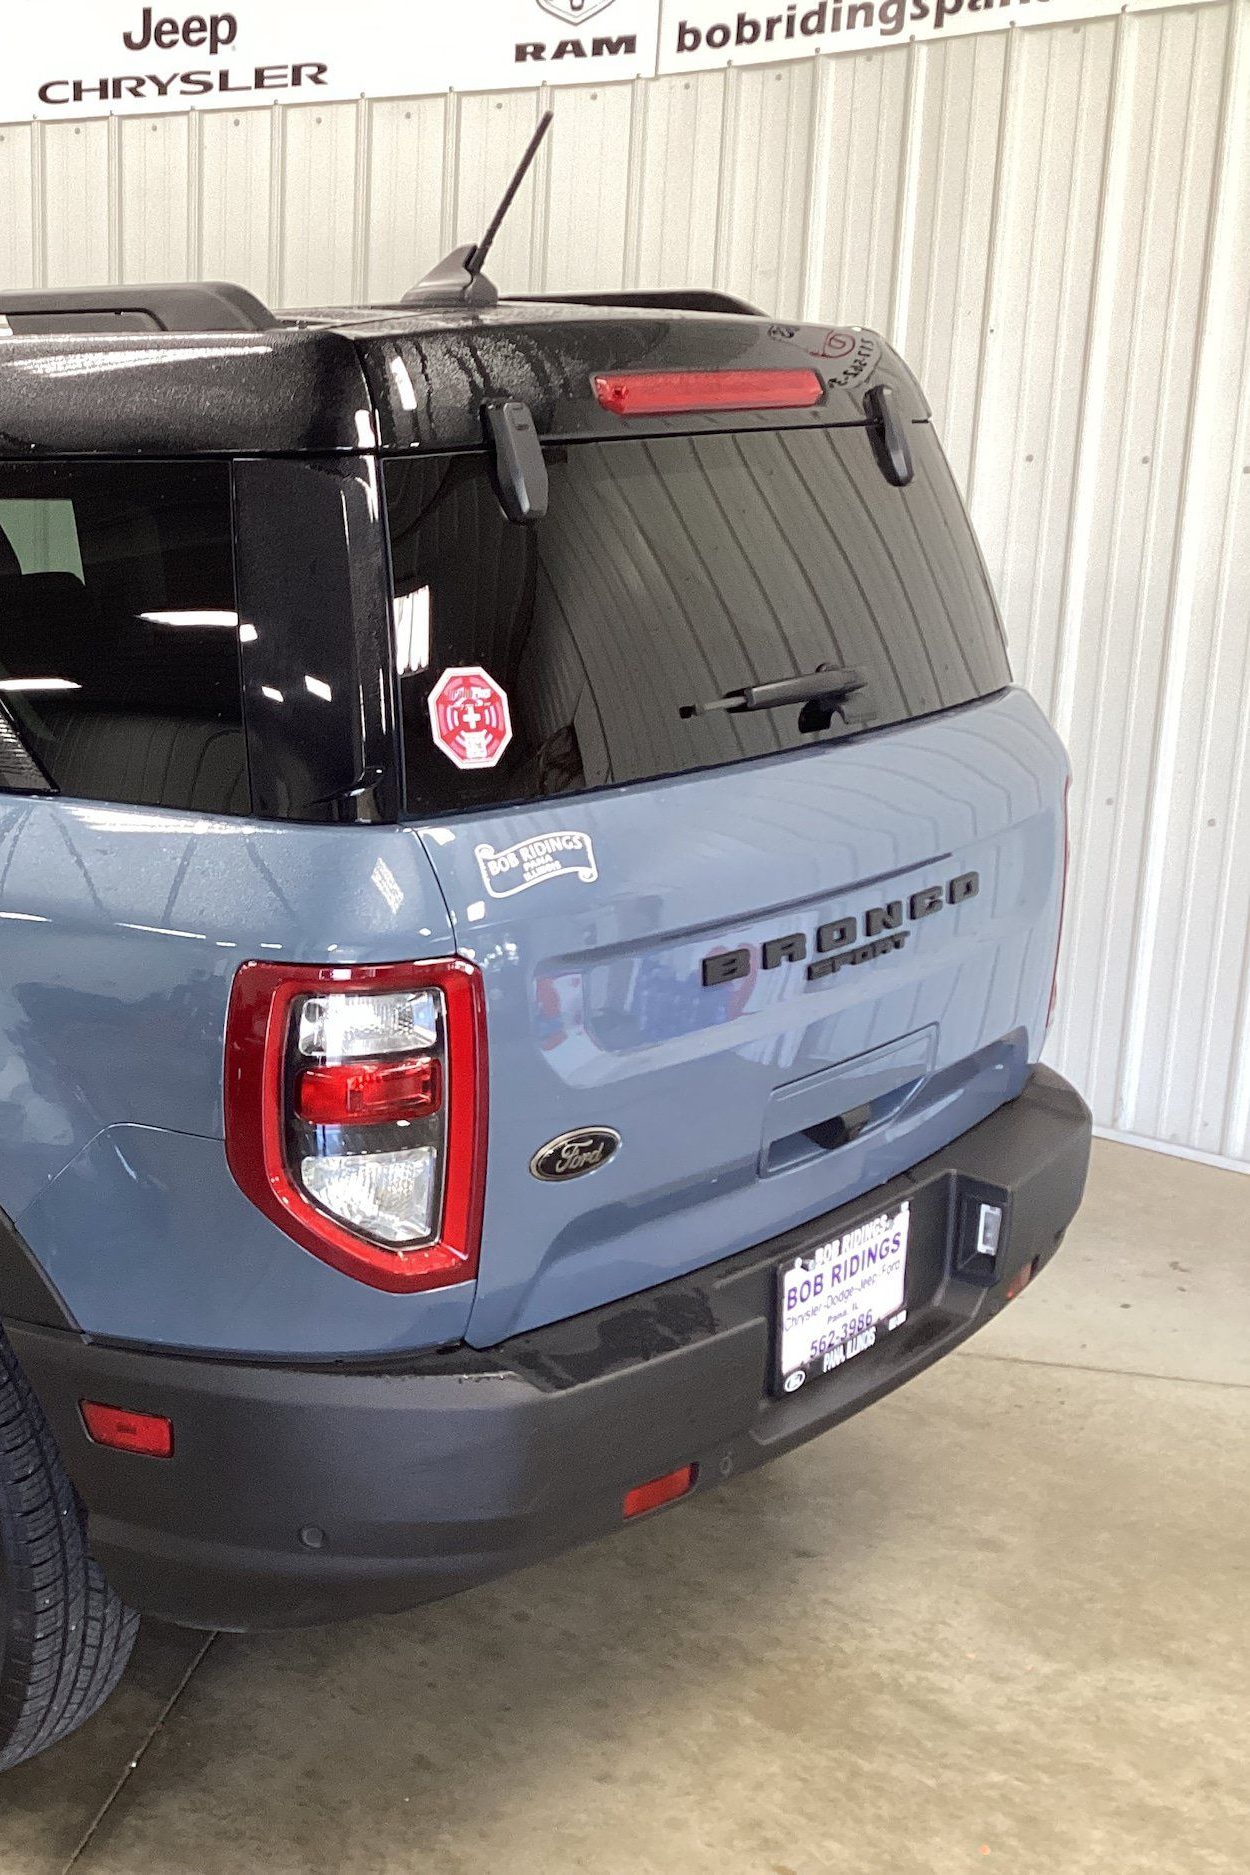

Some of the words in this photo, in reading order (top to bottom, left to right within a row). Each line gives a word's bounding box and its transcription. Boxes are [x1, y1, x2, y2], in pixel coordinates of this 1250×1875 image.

[123, 7, 238, 55] Jeep
[514, 33, 637, 63] RAM
[38, 62, 328, 104] CHRYSLER
[487, 851, 519, 876] BOB
[519, 835, 583, 862] RIDINGS
[702, 871, 980, 987] BRONCO
[807, 930, 911, 981] SPORT
[555, 1139, 605, 1173] Ford
[787, 1273, 824, 1311] BOB
[831, 1231, 902, 1288] RIDINGS
[810, 1309, 873, 1359] 562-3986
